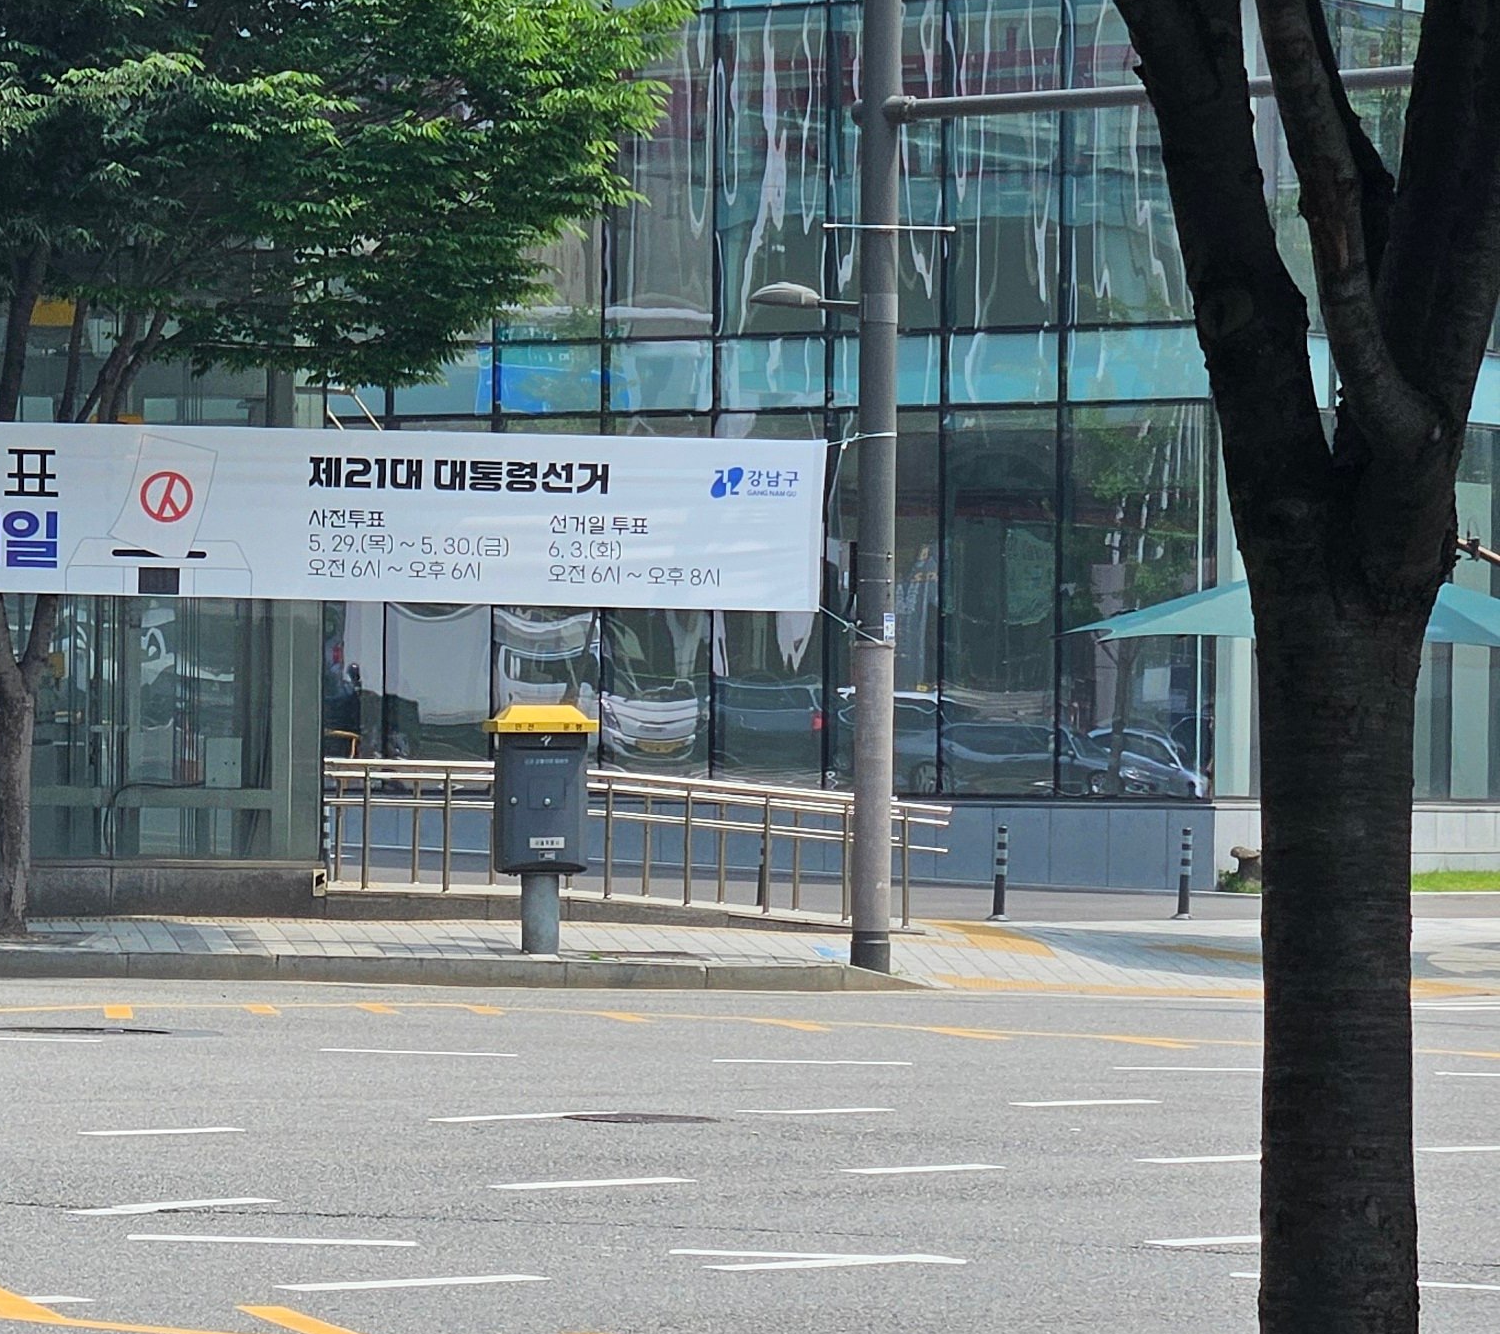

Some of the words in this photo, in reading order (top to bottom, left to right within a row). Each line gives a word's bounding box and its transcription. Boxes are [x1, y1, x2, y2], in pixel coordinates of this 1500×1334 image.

[4, 449, 58, 497] 표
[309, 457, 422, 489] 제21대
[434, 460, 609, 494] 대통령선거
[748, 471, 798, 487] 강남구
[309, 509, 385, 528] 사전투표
[550, 515, 604, 534] 선거일
[611, 517, 648, 535] 투표
[332, 534, 393, 554] 29.(목)
[444, 536, 509, 557] 30.(금)
[571, 540, 621, 560] 3.(화)
[308, 559, 344, 578] 오전
[351, 559, 380, 578] 6시
[408, 561, 445, 580] 오후
[452, 562, 480, 581] 6시
[548, 565, 585, 583] 오전
[592, 566, 620, 584] 6시
[648, 567, 684, 586] 오후
[691, 568, 719, 587] 8시
